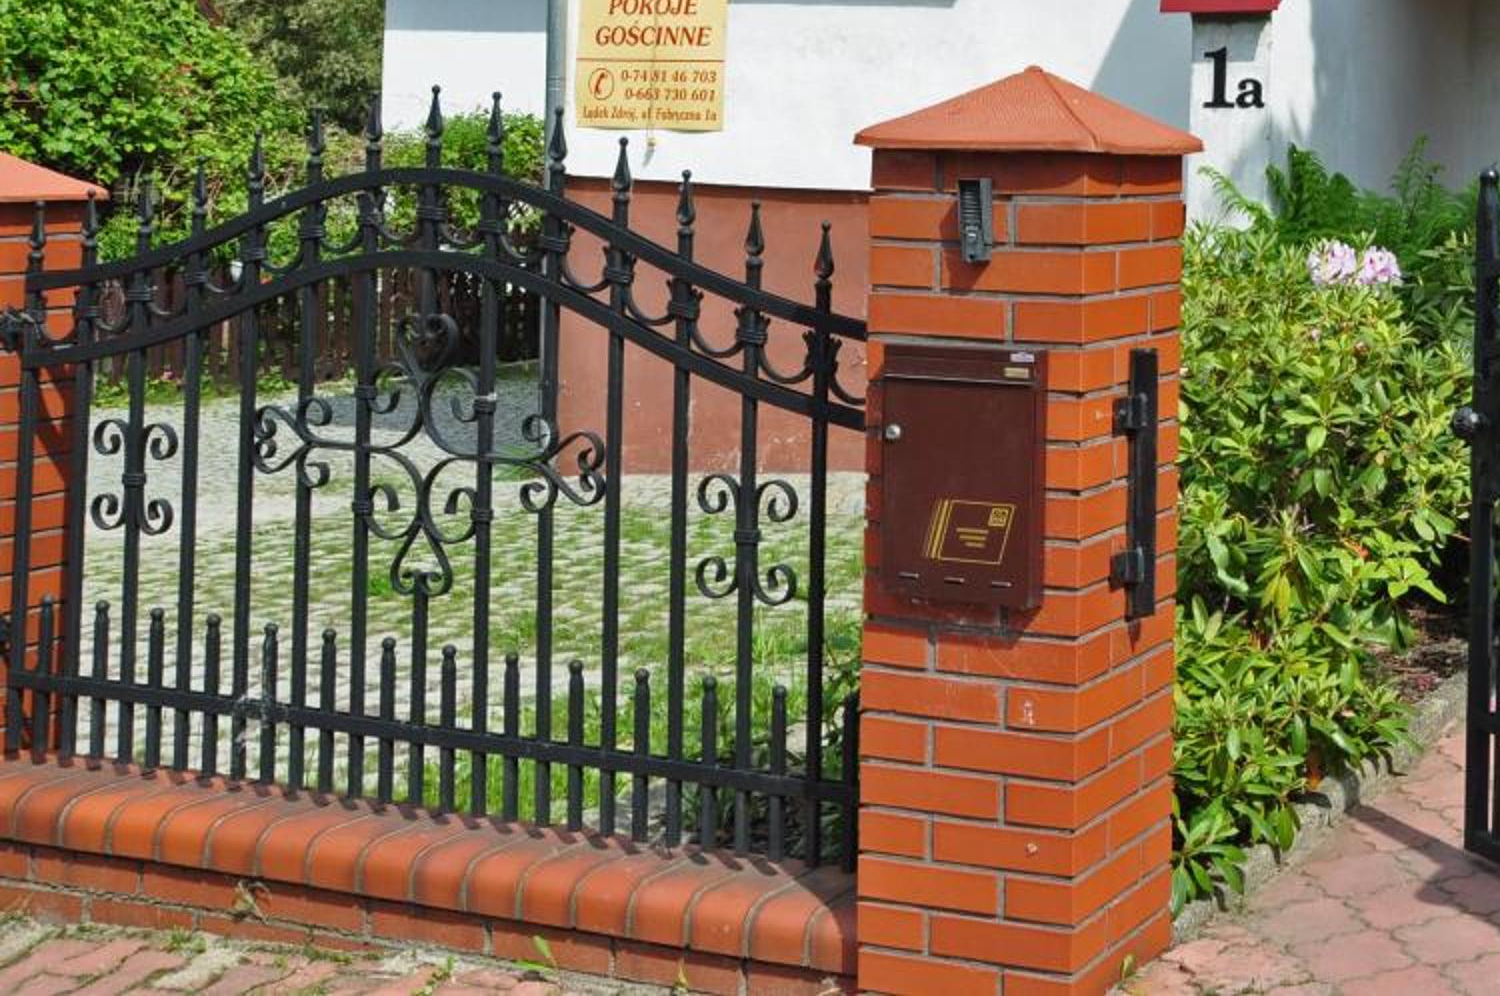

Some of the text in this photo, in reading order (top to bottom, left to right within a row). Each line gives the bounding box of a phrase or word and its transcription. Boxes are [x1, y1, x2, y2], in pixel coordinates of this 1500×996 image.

[595, 20, 712, 47] GOŚCINNE
[693, 71, 717, 84] 703
[1203, 45, 1265, 109] 1a
